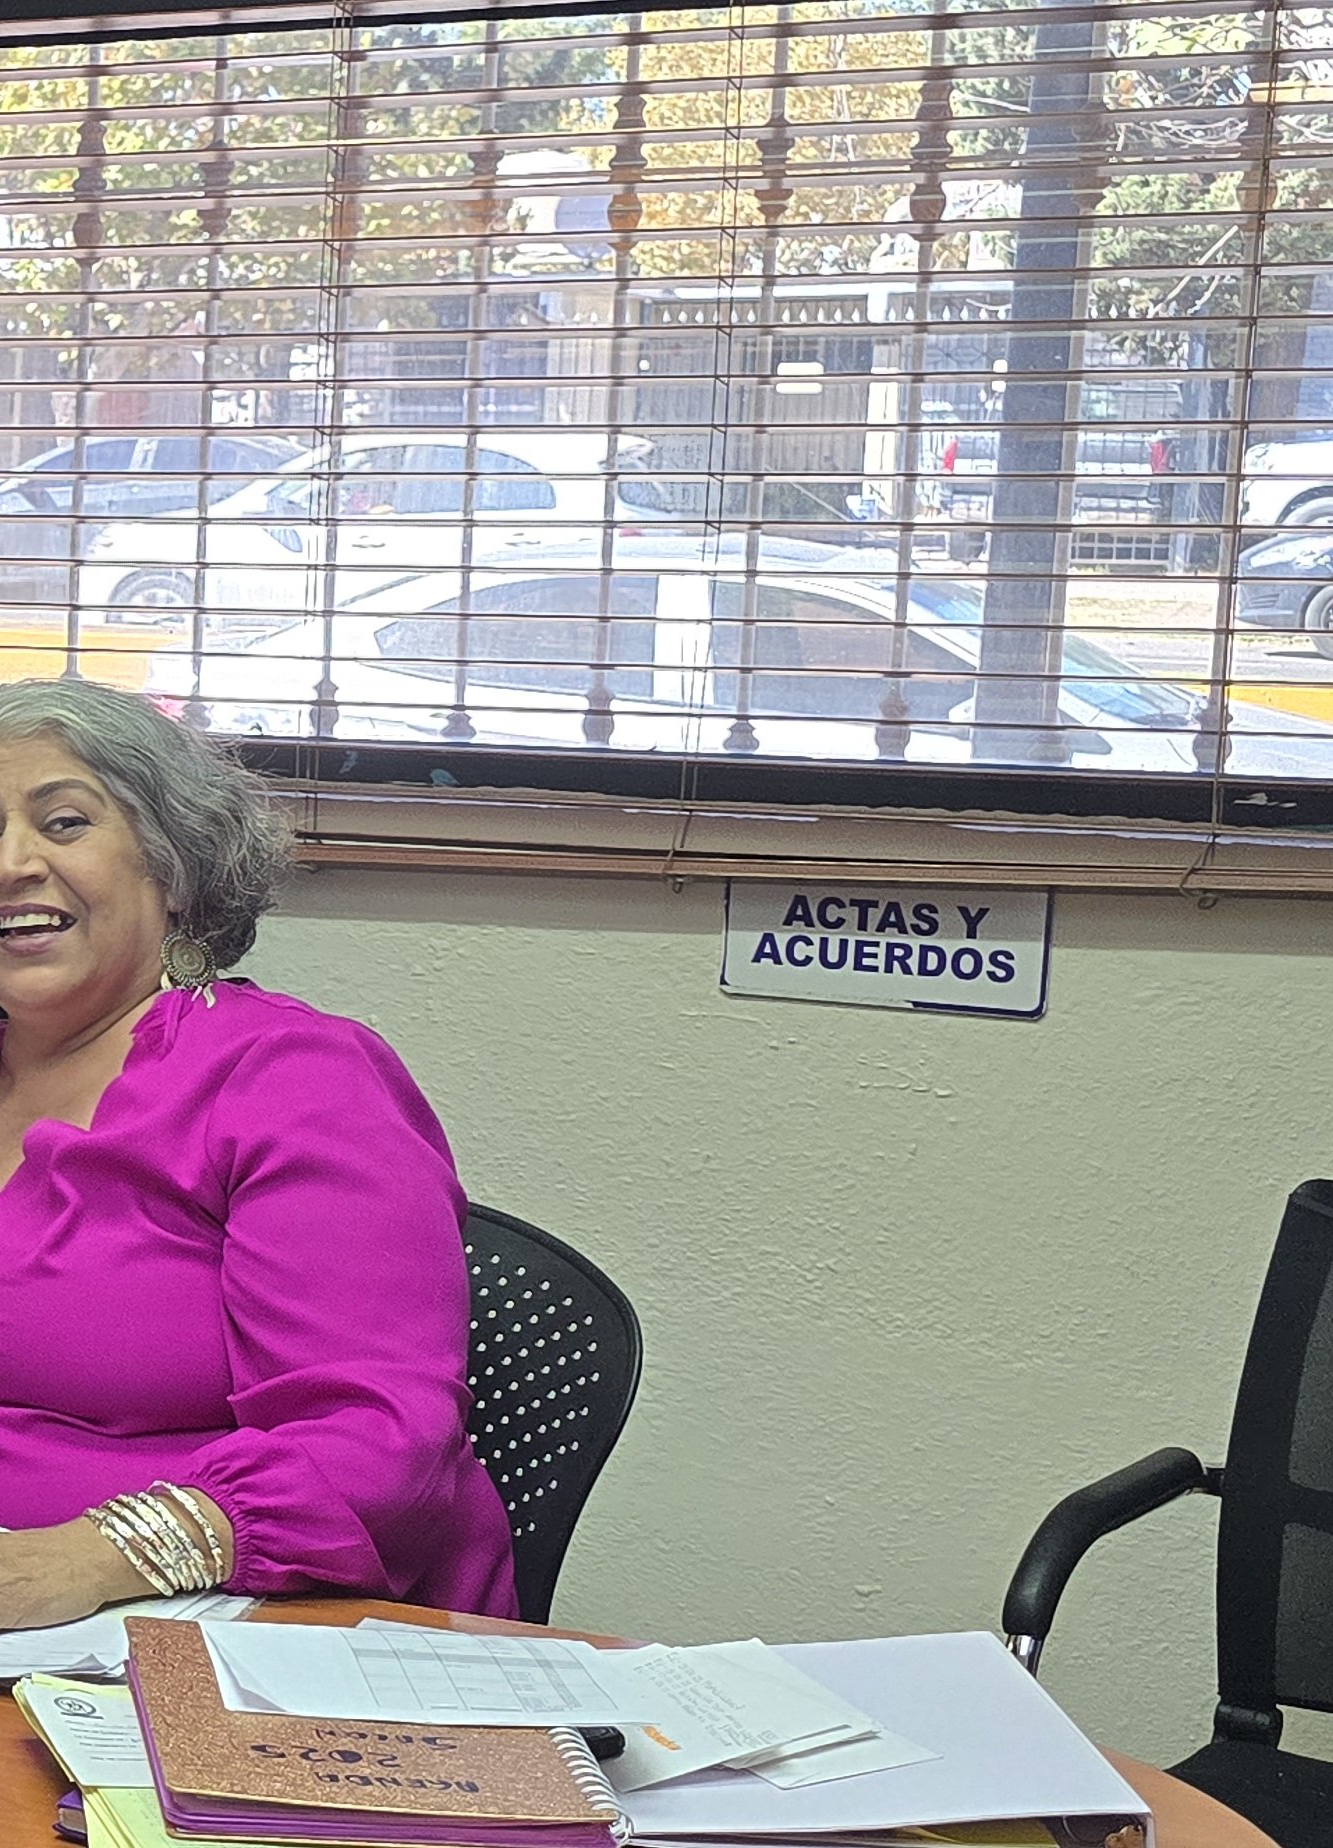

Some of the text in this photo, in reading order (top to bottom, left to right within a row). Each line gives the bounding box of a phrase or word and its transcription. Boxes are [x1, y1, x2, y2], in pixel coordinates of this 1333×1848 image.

[783, 894, 990, 939] ACTAS Y
[751, 932, 1016, 983] ACUERDOS
[249, 1744, 403, 1768] 2025
[314, 1771, 480, 1793] AGENDA
